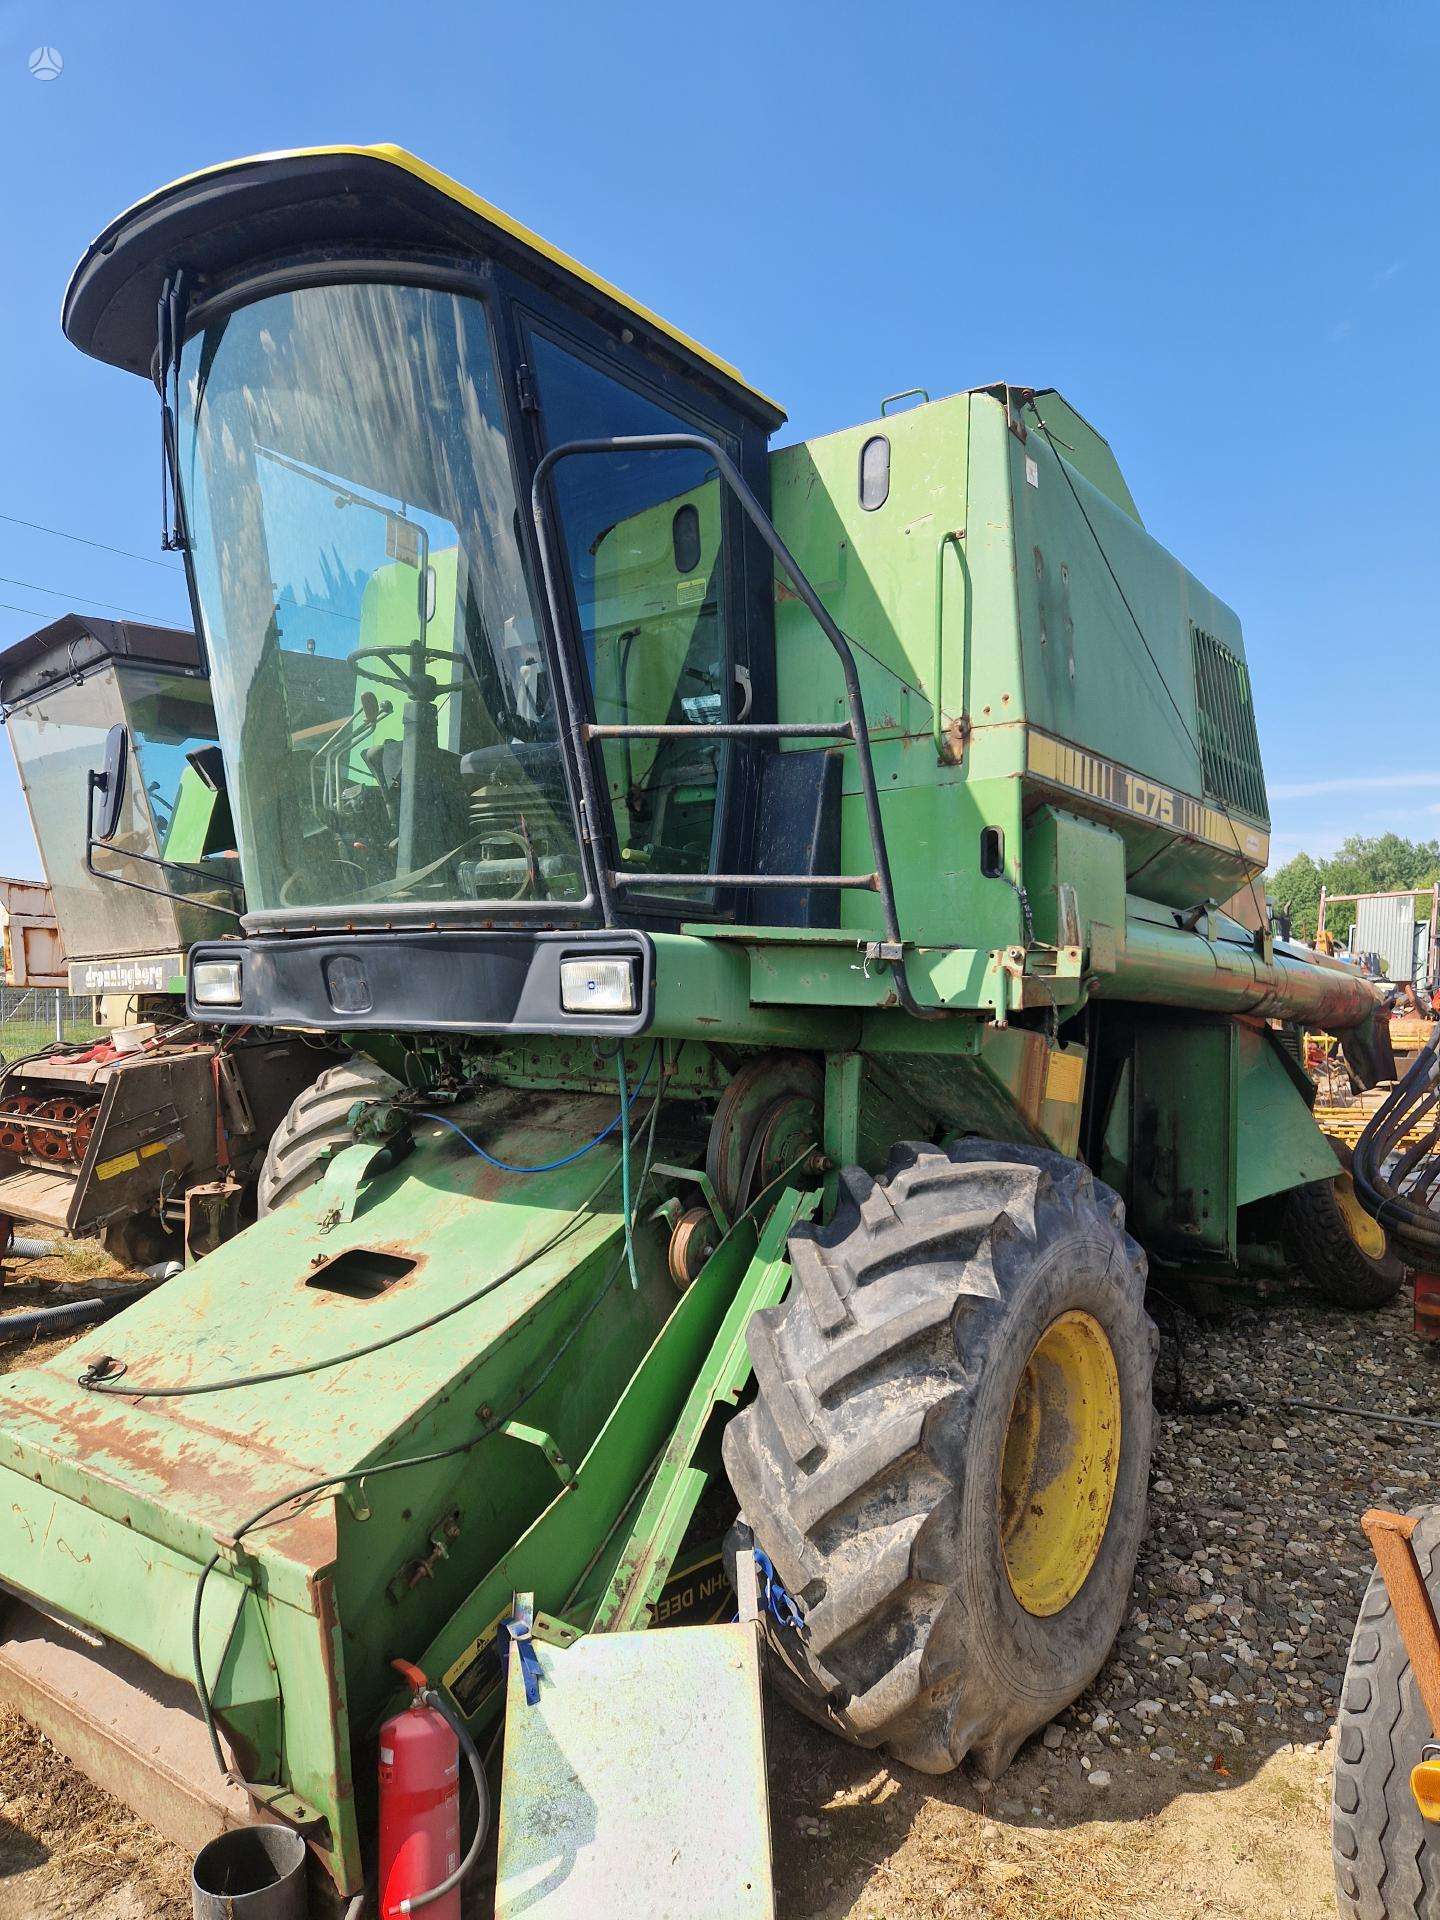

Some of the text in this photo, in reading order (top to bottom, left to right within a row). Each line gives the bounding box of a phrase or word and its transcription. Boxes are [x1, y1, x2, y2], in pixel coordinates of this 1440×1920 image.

[1125, 774, 1174, 825] 1075
[86, 963, 163, 990] dronningborg
[649, 1573, 729, 1625] OHN DEER
